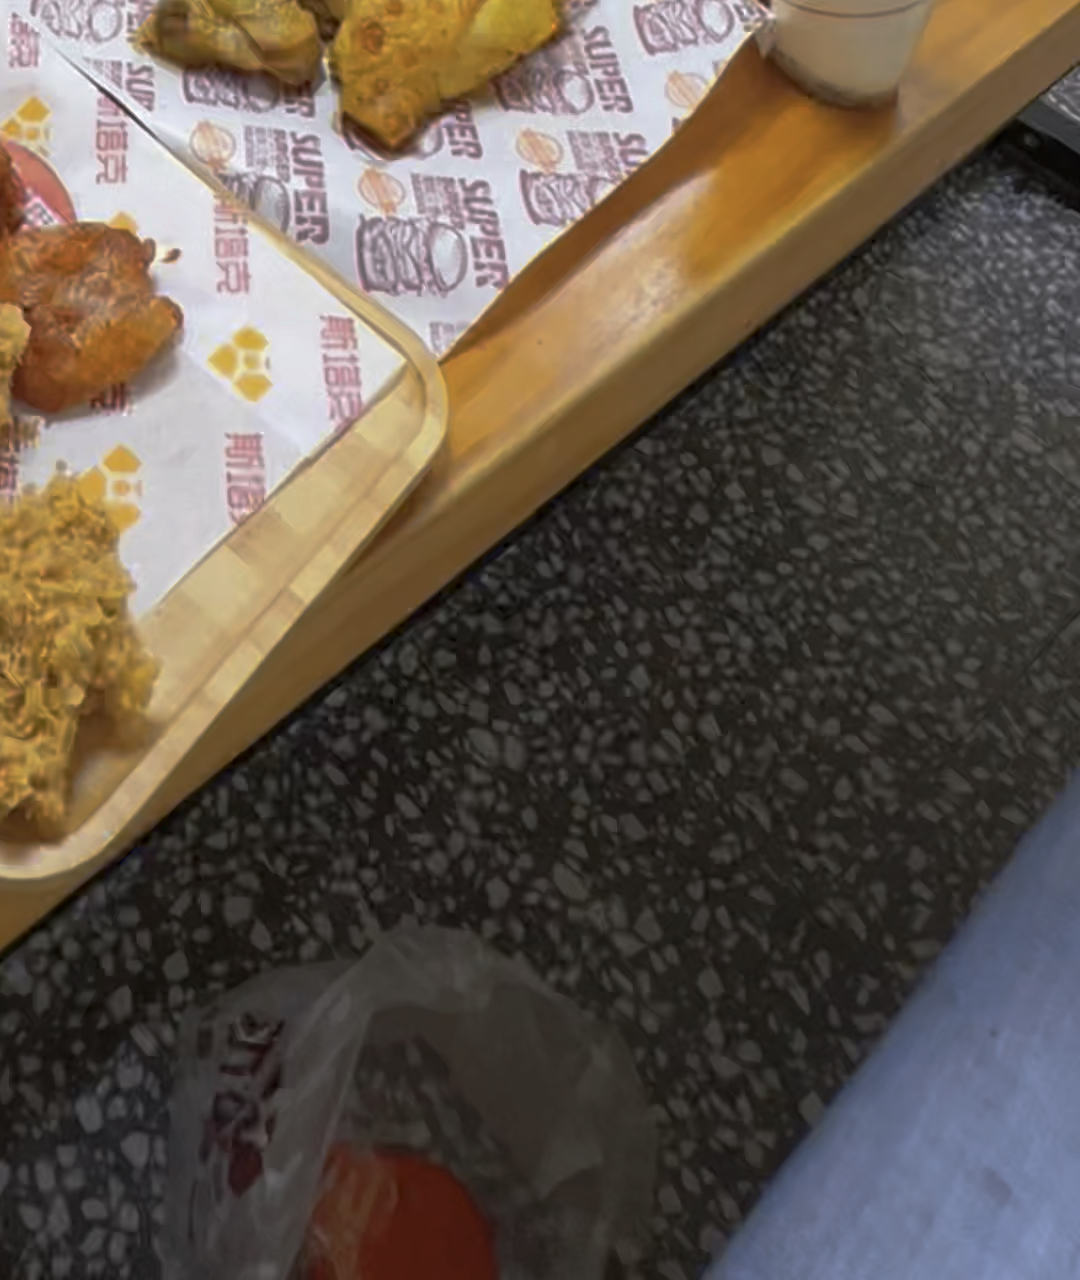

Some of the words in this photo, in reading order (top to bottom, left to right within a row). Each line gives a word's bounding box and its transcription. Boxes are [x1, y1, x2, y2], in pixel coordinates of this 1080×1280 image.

[584, 25, 634, 114] SUPER
[290, 131, 330, 245] SUPER
[458, 178, 510, 290] SUPER
